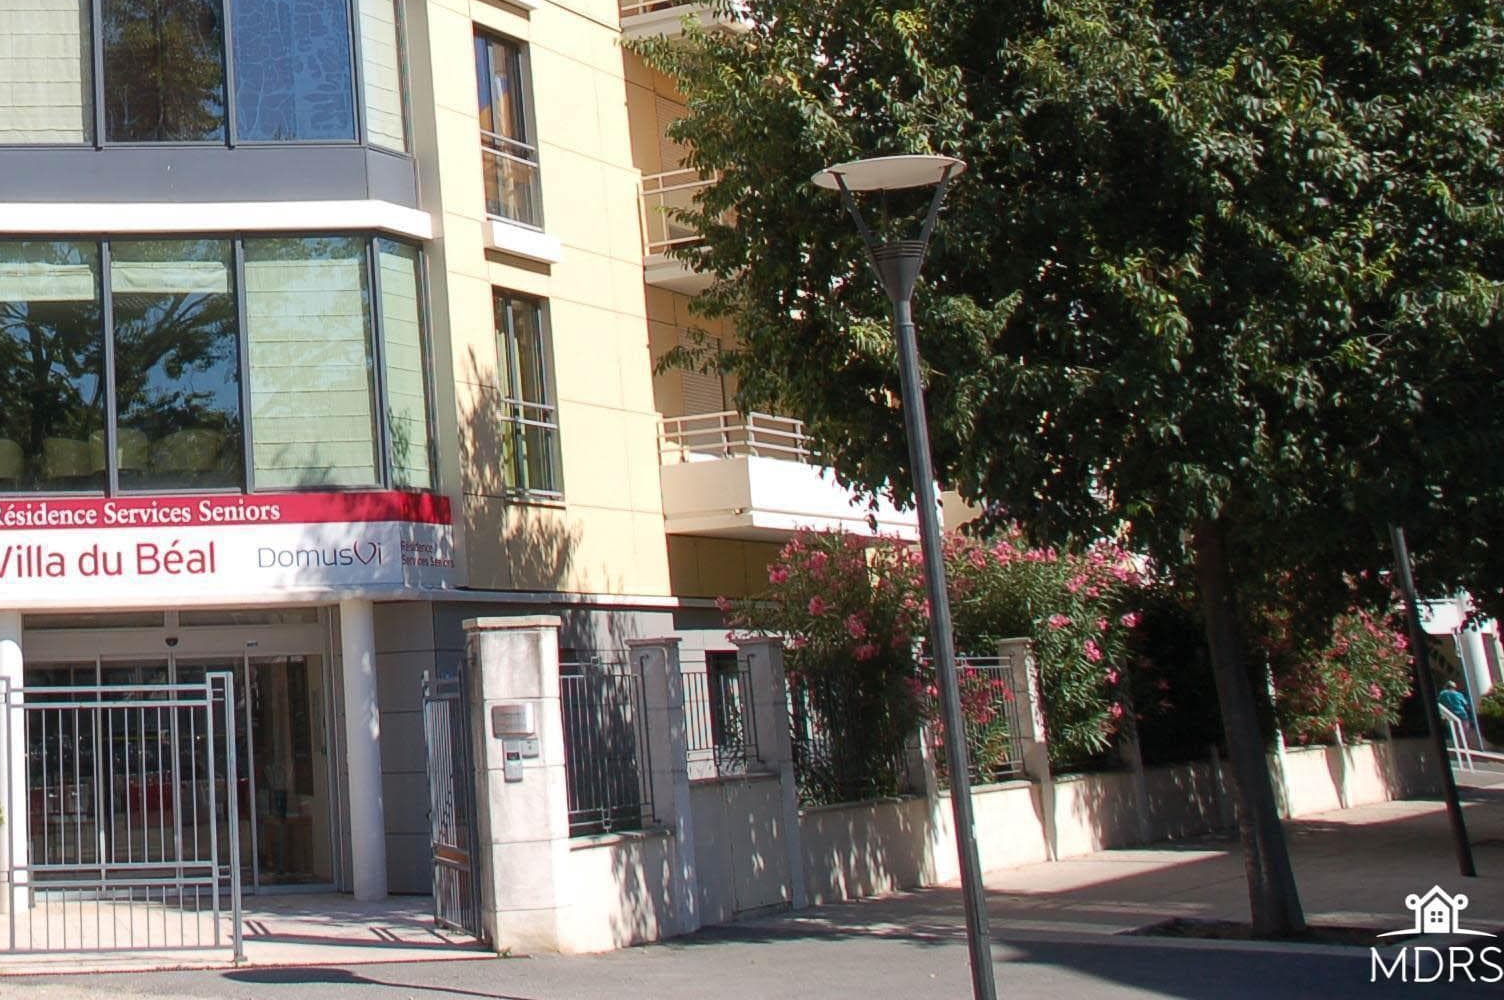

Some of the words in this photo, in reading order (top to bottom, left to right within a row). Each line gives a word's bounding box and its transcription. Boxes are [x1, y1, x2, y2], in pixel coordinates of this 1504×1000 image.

[104, 501, 192, 525] Services
[198, 499, 281, 522] Seniors
[77, 543, 124, 577] du
[136, 538, 217, 576] Béal
[258, 540, 383, 569] DomusVi
